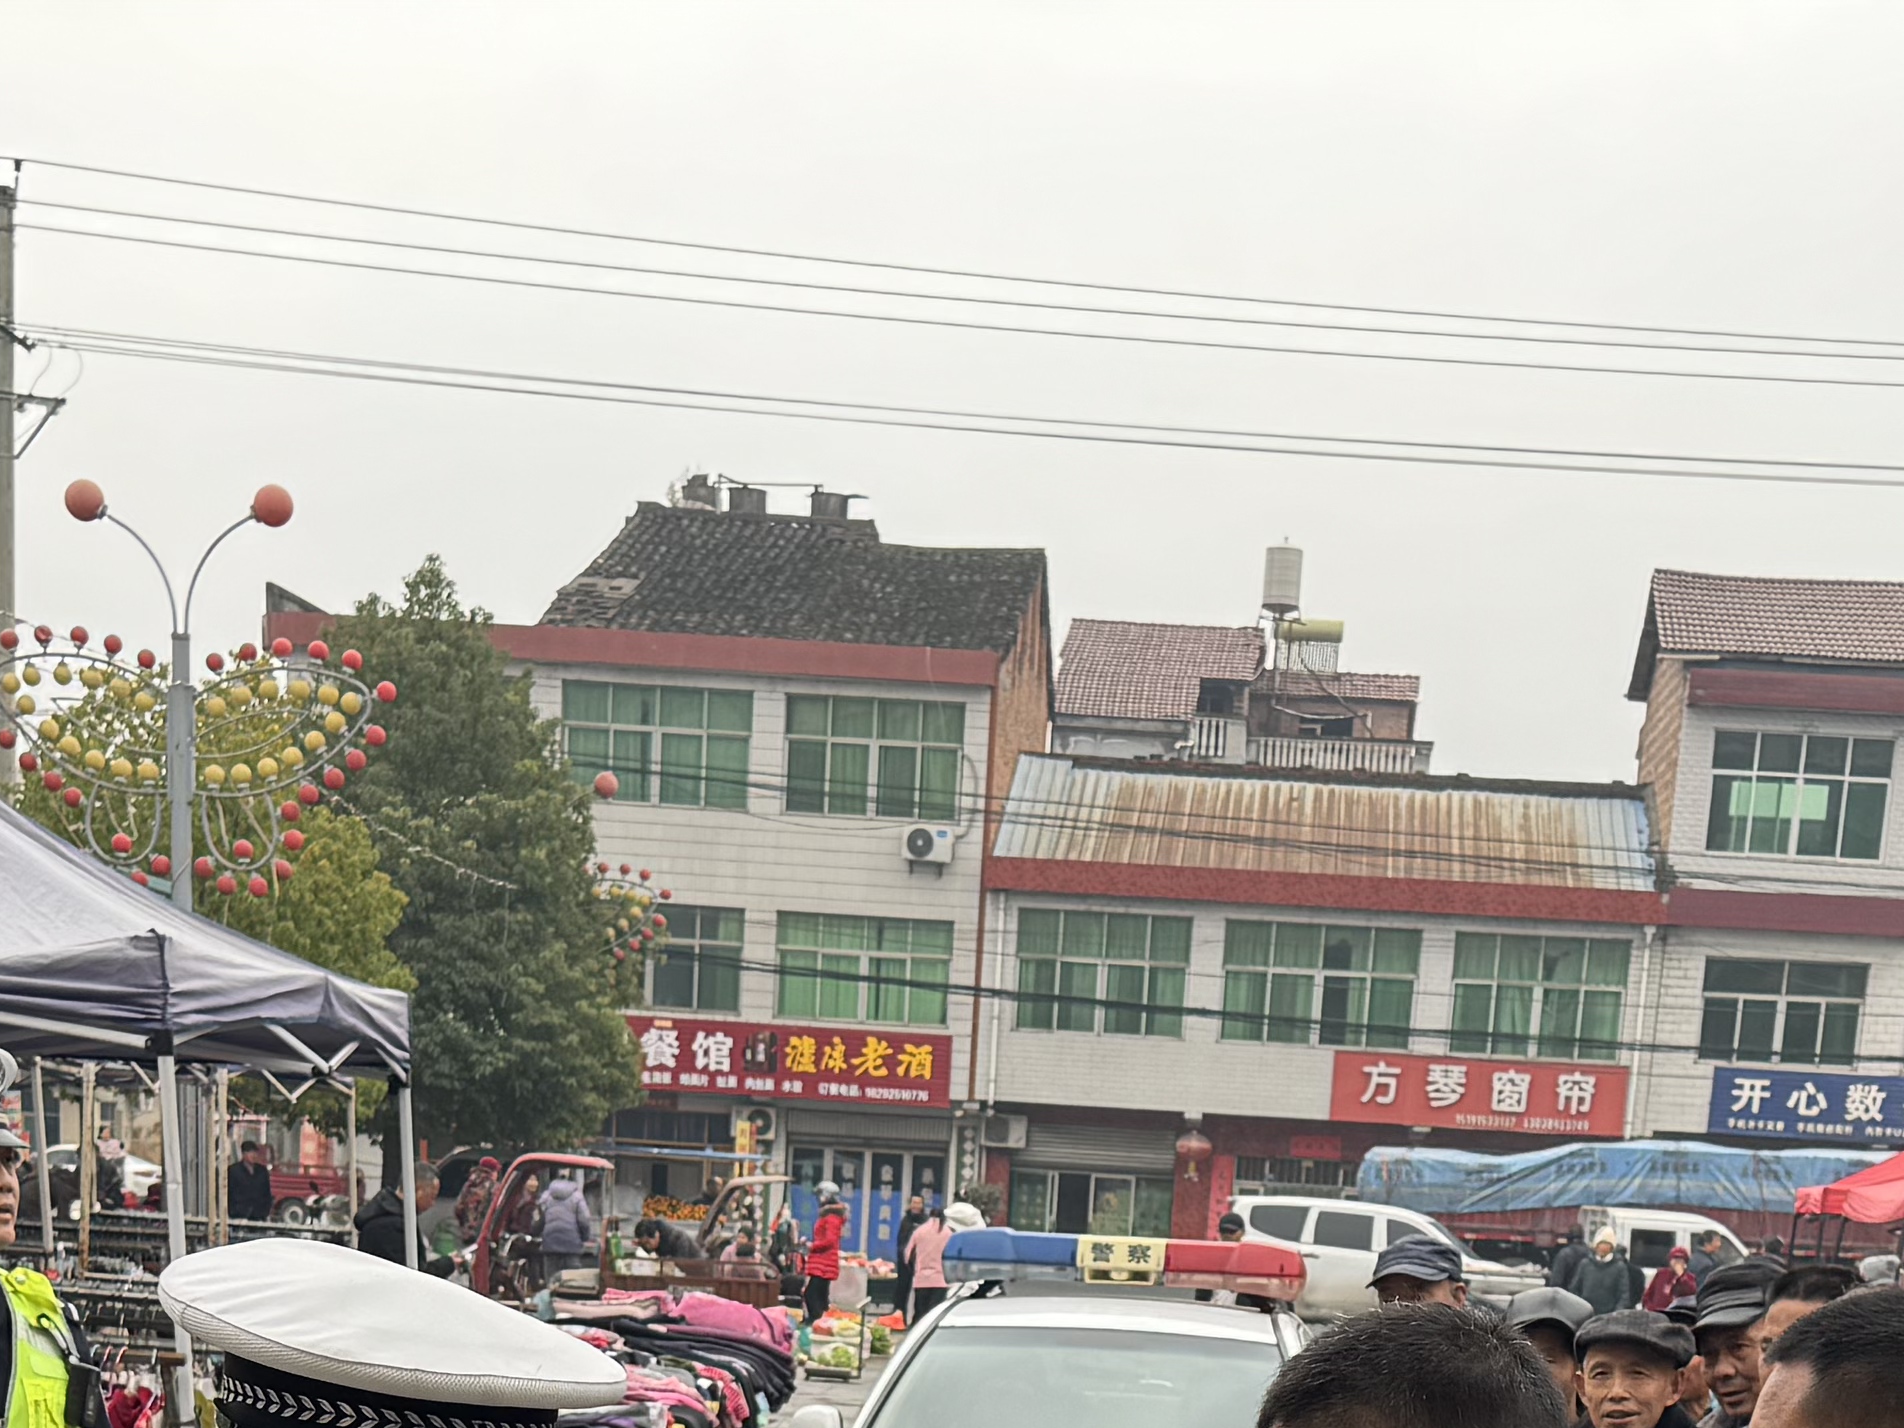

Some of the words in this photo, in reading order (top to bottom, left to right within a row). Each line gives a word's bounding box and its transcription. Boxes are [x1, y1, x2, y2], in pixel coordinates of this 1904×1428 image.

[641, 1027, 733, 1073] 餐馆
[1360, 1061, 1596, 1115] 方琴窗帘
[1091, 1242, 1152, 1264] 警察
